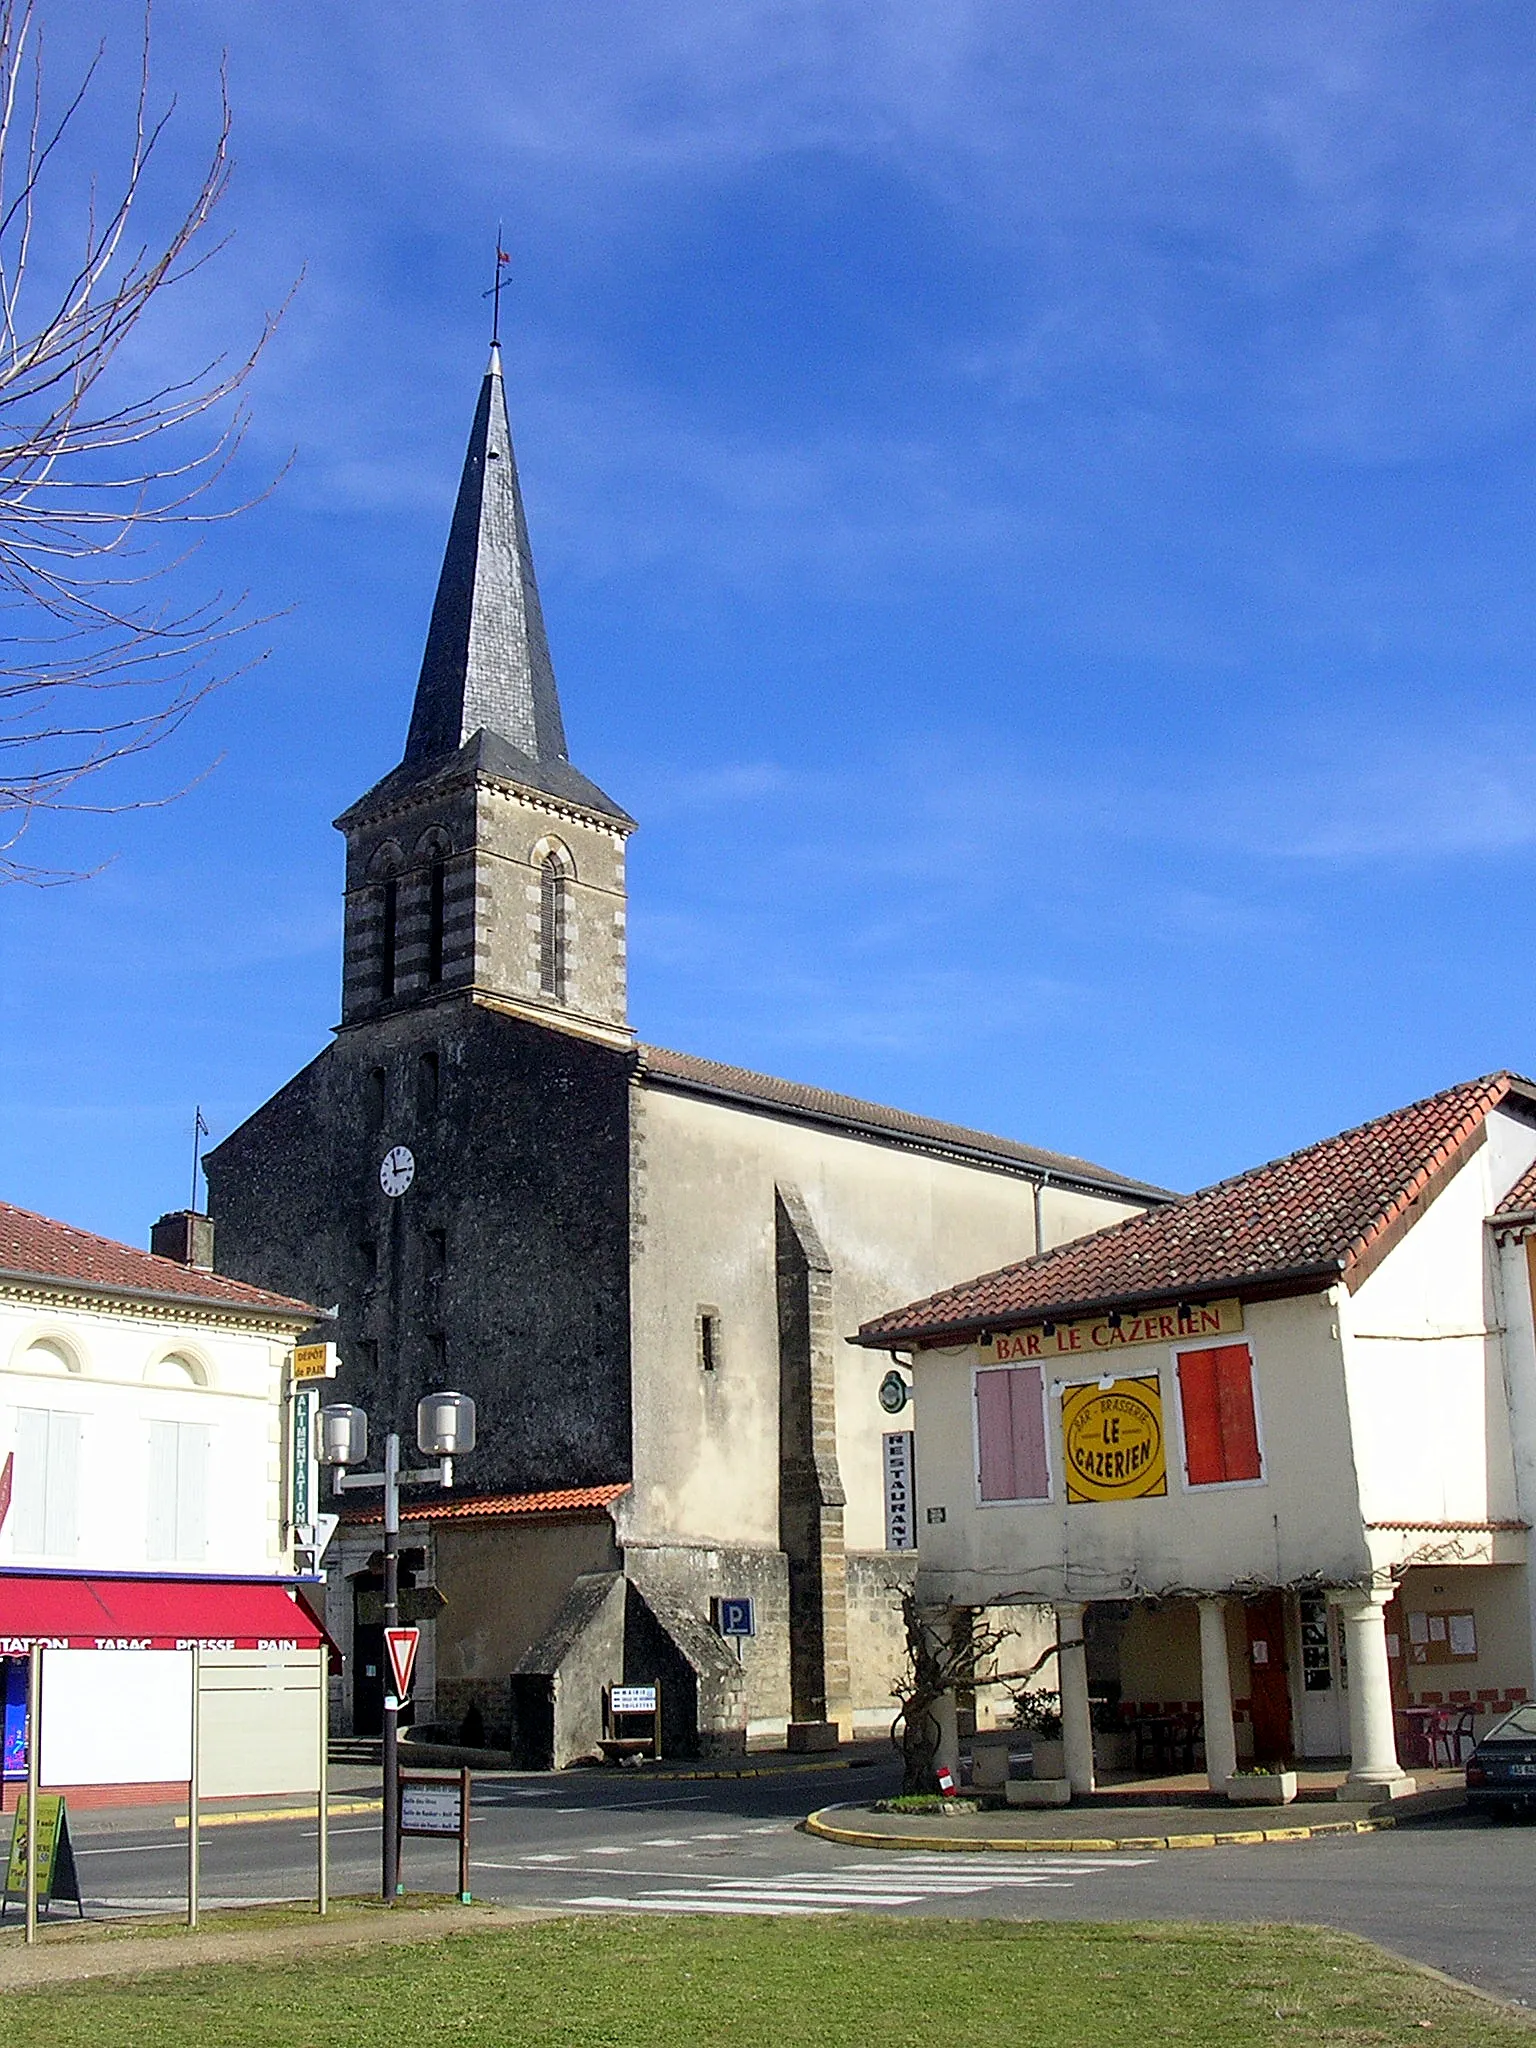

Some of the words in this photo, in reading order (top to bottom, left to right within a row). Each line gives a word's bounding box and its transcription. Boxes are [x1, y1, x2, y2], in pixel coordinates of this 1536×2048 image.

[996, 1334, 1042, 1360] BAR
[1057, 1328, 1082, 1351] LE
[1091, 1308, 1221, 1347] CAZERIEN
[1100, 1398, 1150, 1425] BRASSERIE
[1103, 1417, 1120, 1445] LE
[296, 1395, 307, 1525] ALIMENTATION
[1074, 1437, 1152, 1479] CAZERIEN
[888, 1435, 908, 1547] RESTAURANT
[94, 1638, 152, 1650] TABAC
[175, 1639, 236, 1651] PRESSE
[257, 1639, 297, 1651] PAIN
